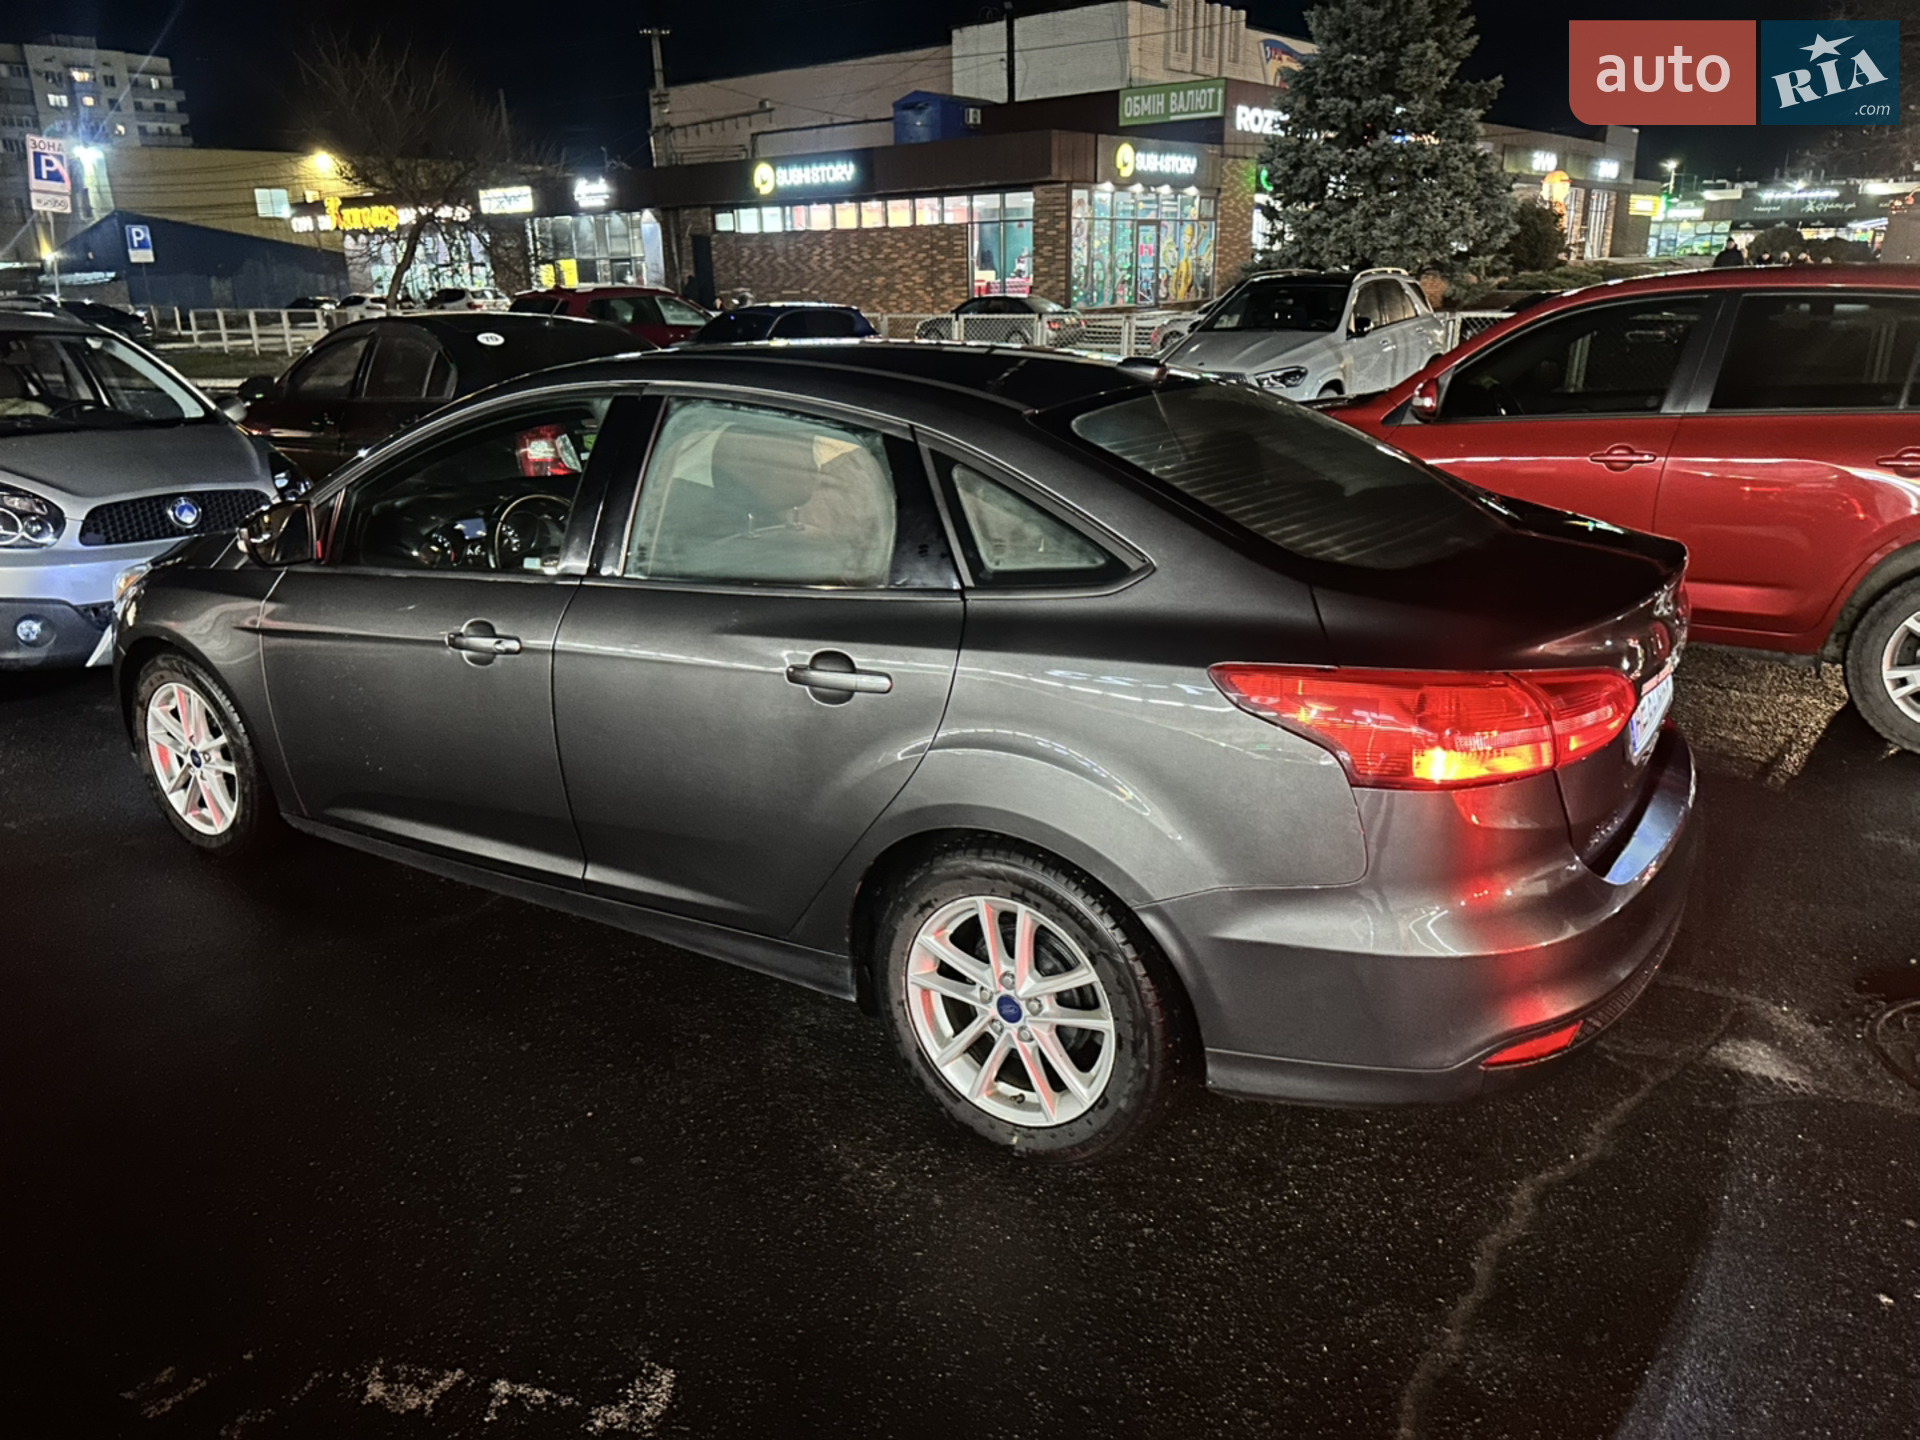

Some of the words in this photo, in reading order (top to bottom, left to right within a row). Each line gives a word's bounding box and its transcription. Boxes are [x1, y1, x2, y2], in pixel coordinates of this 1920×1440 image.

[1124, 93, 1165, 118] ОБМІН
[1169, 87, 1215, 113] ВАЛЮТ
[30, 138, 65, 152] ЗОНА
